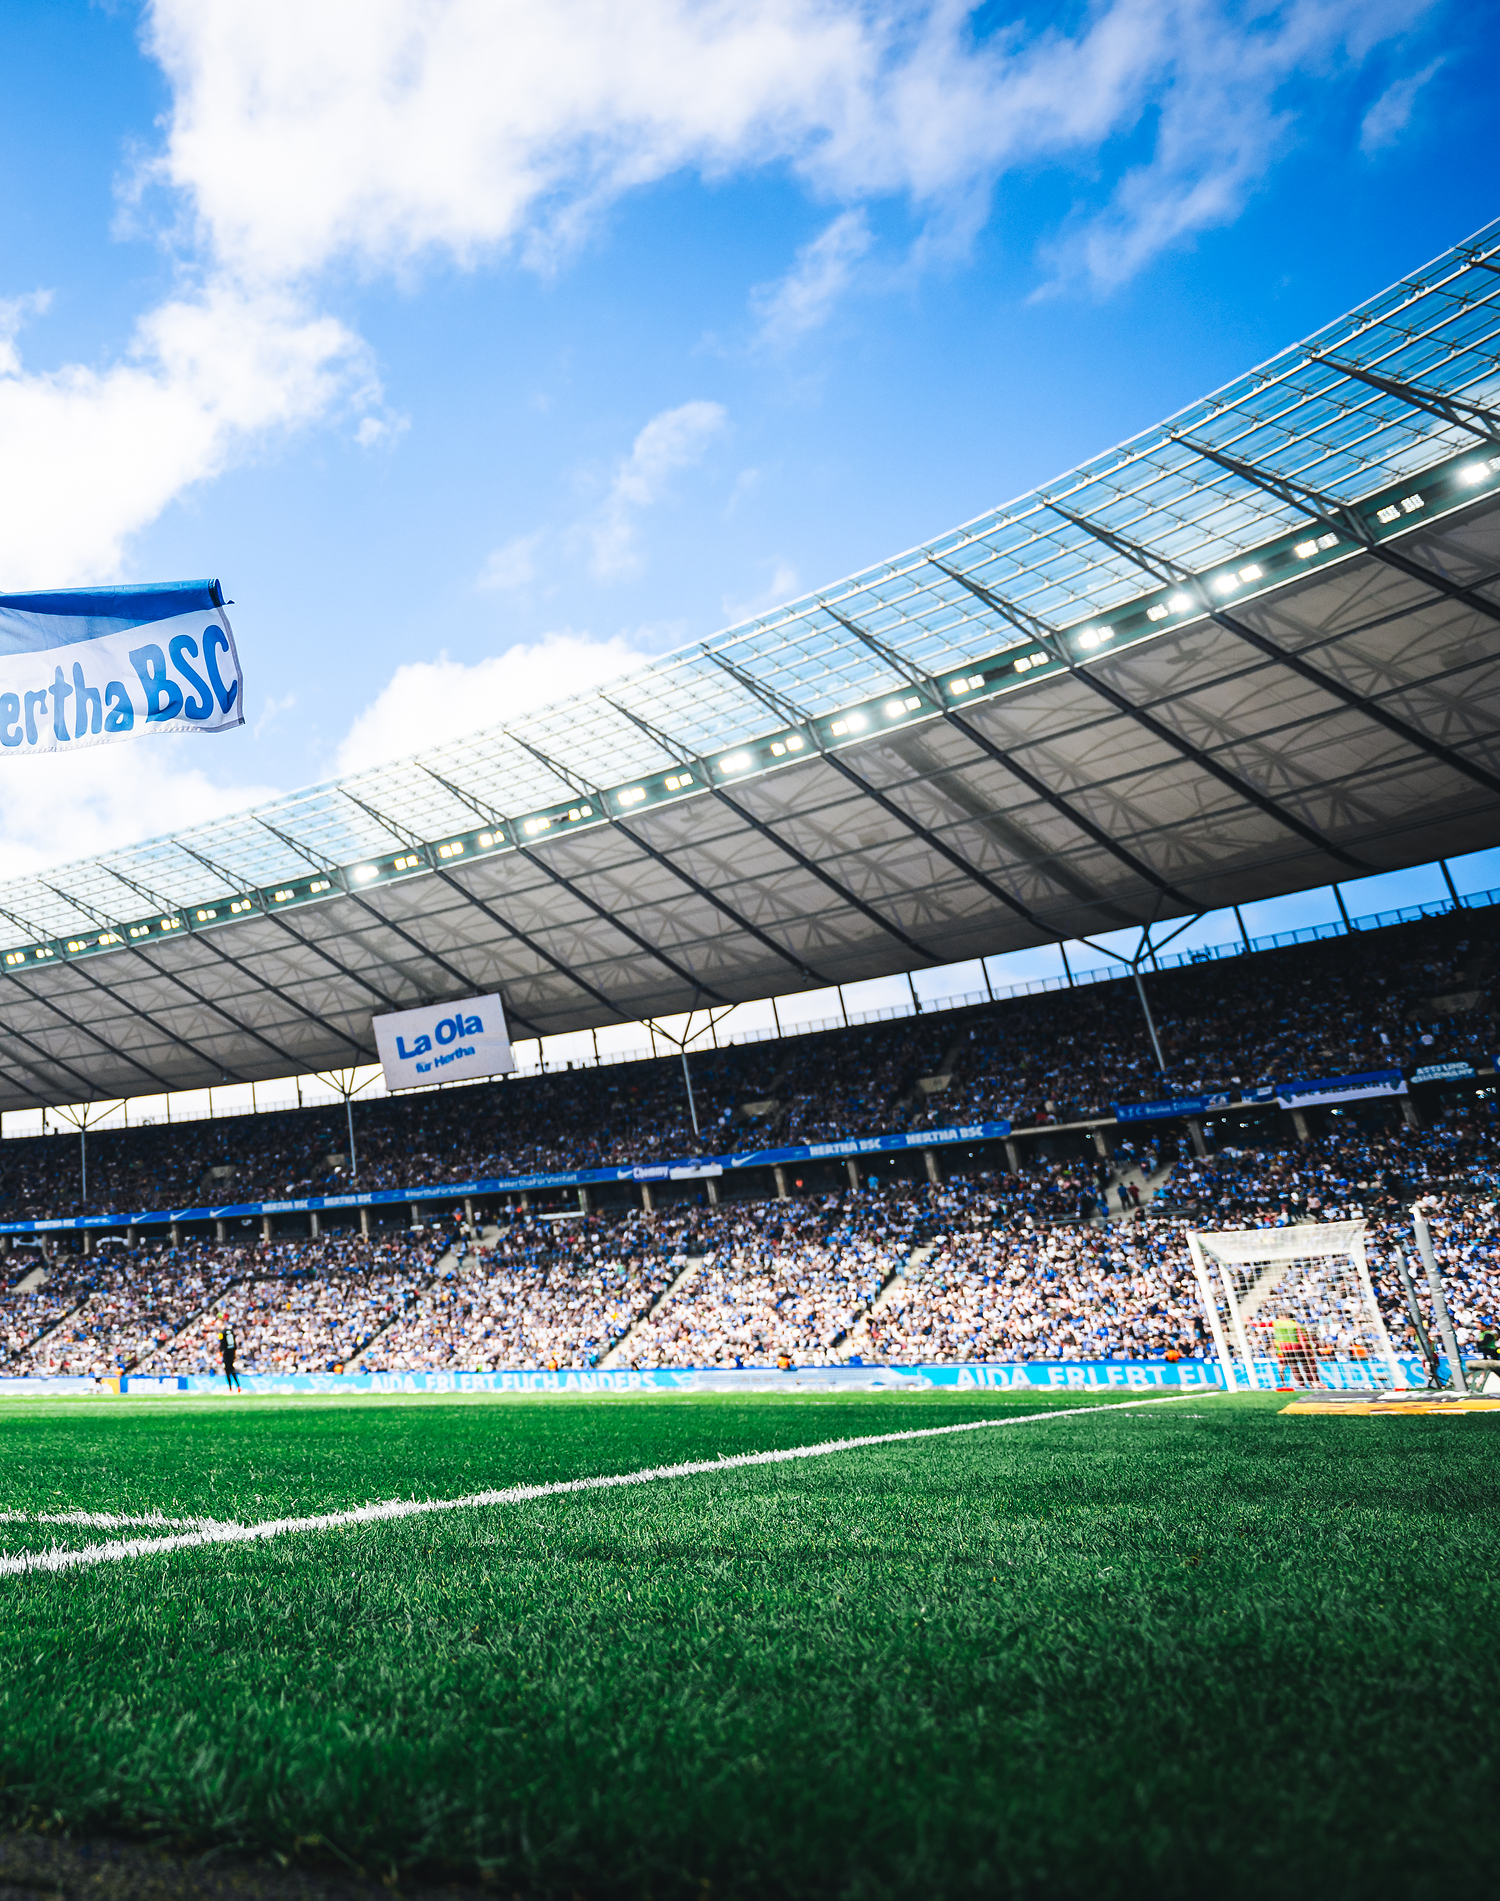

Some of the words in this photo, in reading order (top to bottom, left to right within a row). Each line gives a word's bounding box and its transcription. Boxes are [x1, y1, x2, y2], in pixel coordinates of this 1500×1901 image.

[128, 624, 238, 724] BSC
[396, 1034, 432, 1060] La
[435, 1013, 485, 1046] Ola
[415, 1062, 433, 1074] für
[434, 1046, 476, 1068] Hertha
[809, 1141, 858, 1157] HERTHA
[859, 1138, 882, 1151] BSC
[905, 1129, 958, 1145] HERTHA
[959, 1126, 984, 1139] BSC
